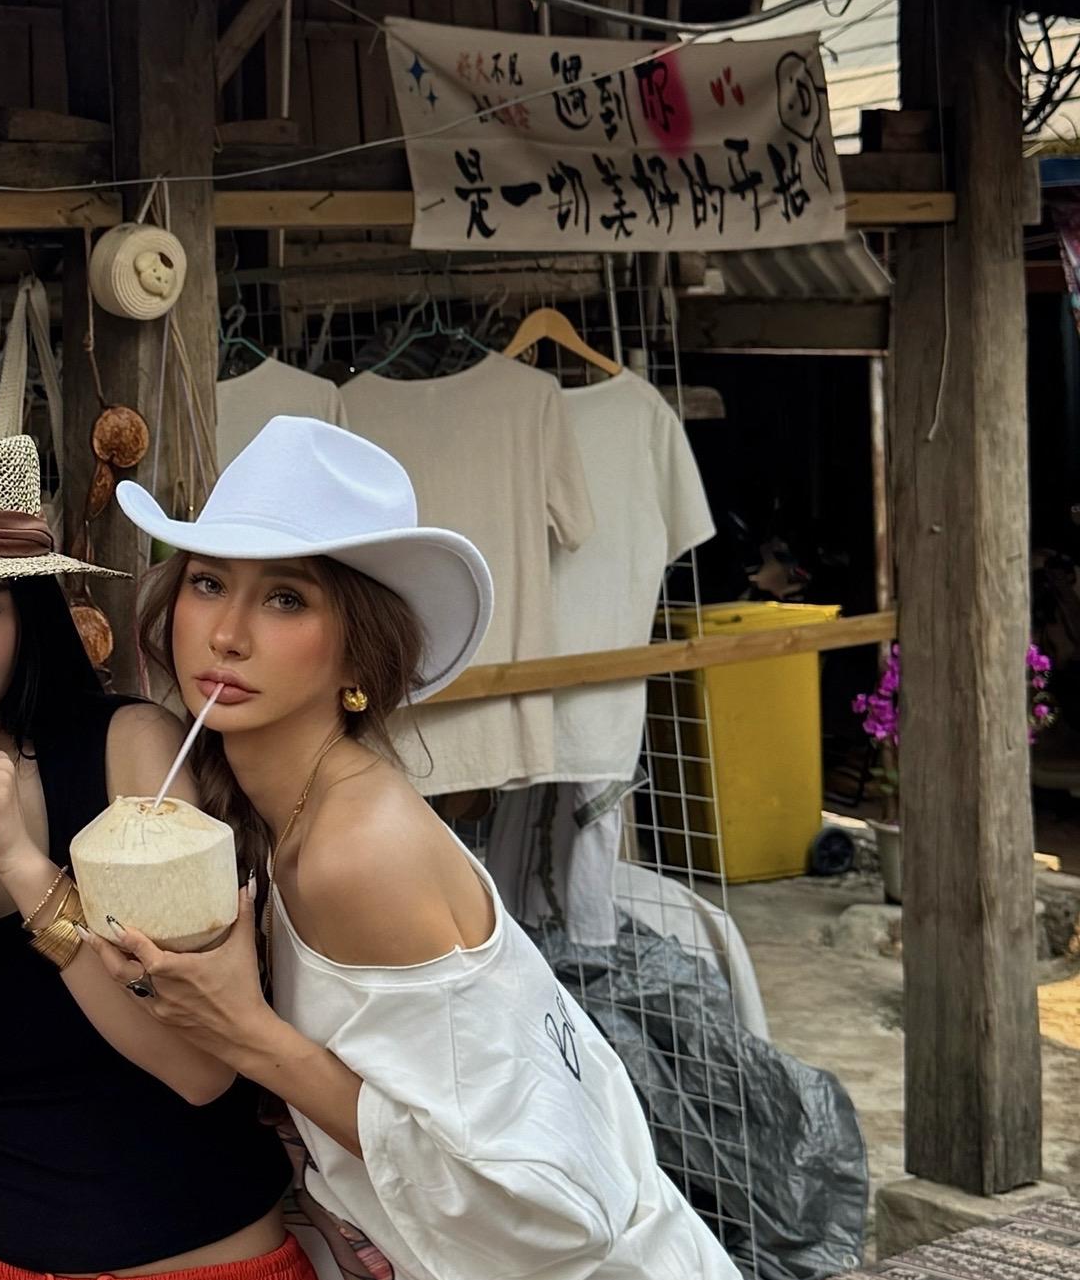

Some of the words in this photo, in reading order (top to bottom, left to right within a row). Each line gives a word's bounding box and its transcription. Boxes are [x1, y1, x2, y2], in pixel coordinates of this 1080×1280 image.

[551, 50, 675, 144] 遇到你
[454, 138, 811, 239] 是一切美好的开始
